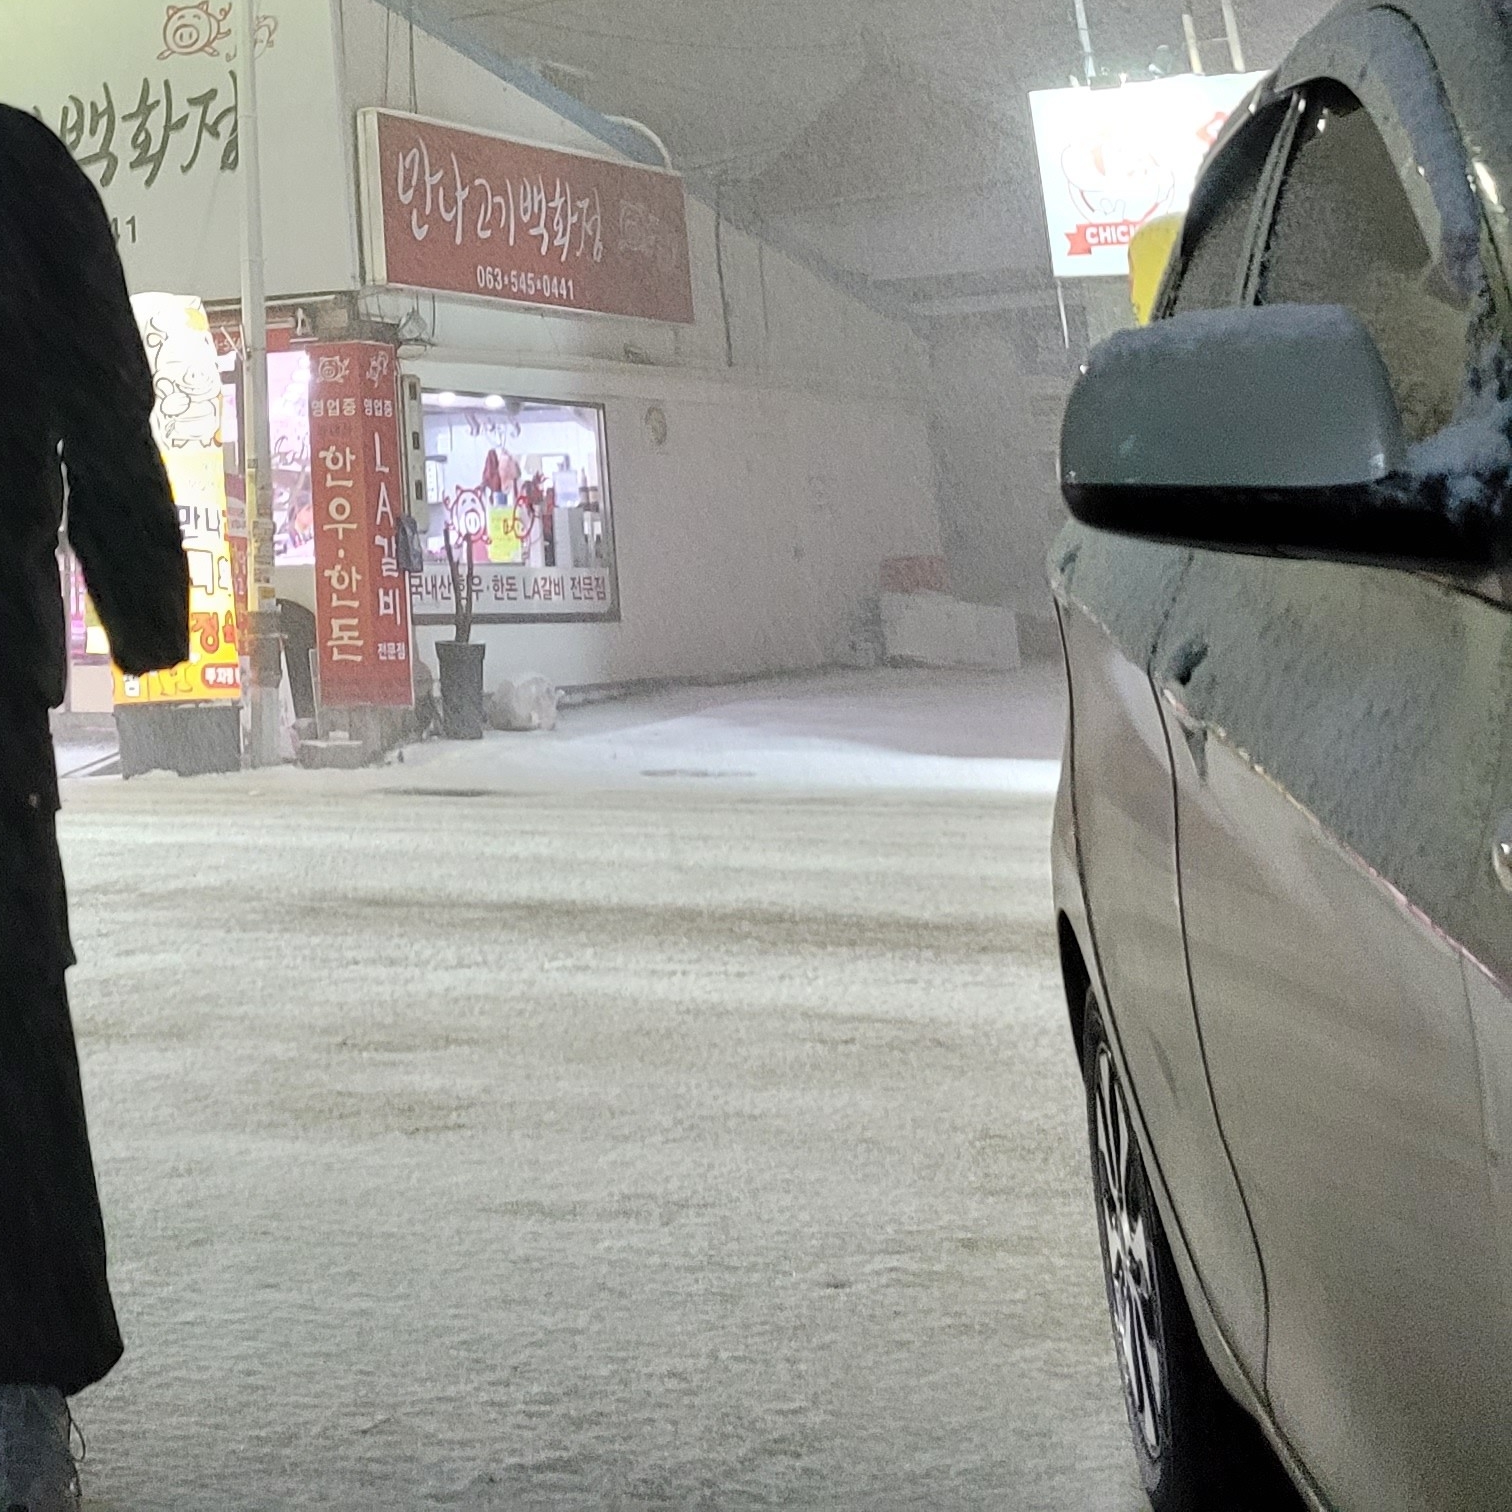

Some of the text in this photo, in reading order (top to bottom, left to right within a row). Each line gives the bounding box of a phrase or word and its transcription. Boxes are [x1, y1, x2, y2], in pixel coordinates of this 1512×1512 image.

[311, 397, 357, 418] 영업중
[363, 397, 393, 418] 영업중
[410, 574, 452, 601] 국내산
[522, 574, 566, 601] LA갈비
[570, 574, 607, 601] 전문점
[377, 641, 406, 661] 전문점
